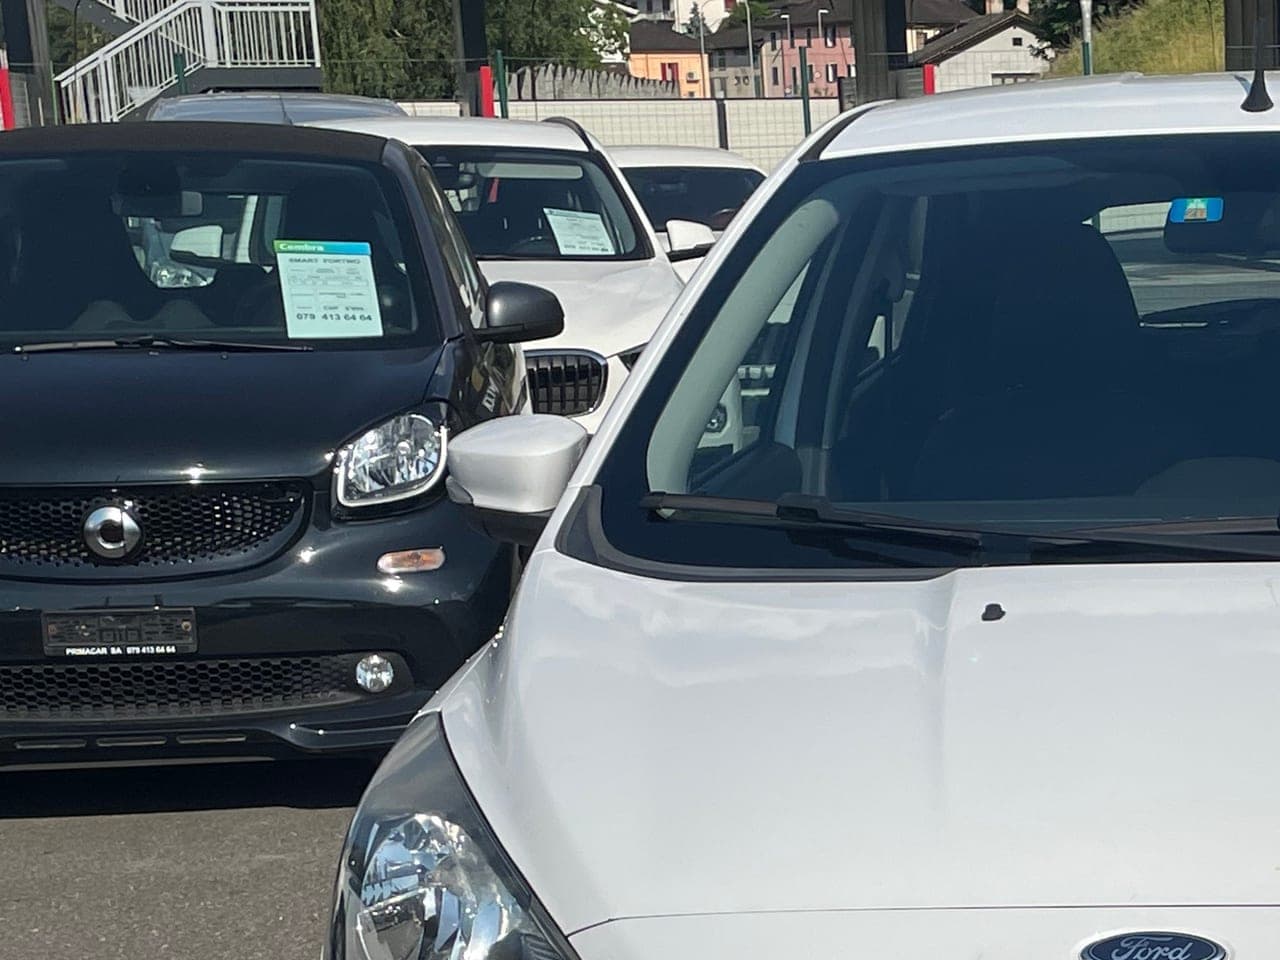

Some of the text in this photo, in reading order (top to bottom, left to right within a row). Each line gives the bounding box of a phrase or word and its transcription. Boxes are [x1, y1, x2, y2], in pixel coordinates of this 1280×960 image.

[296, 312, 316, 321] 079
[321, 313, 341, 321] 413
[65, 647, 108, 655] PRIMACAR
